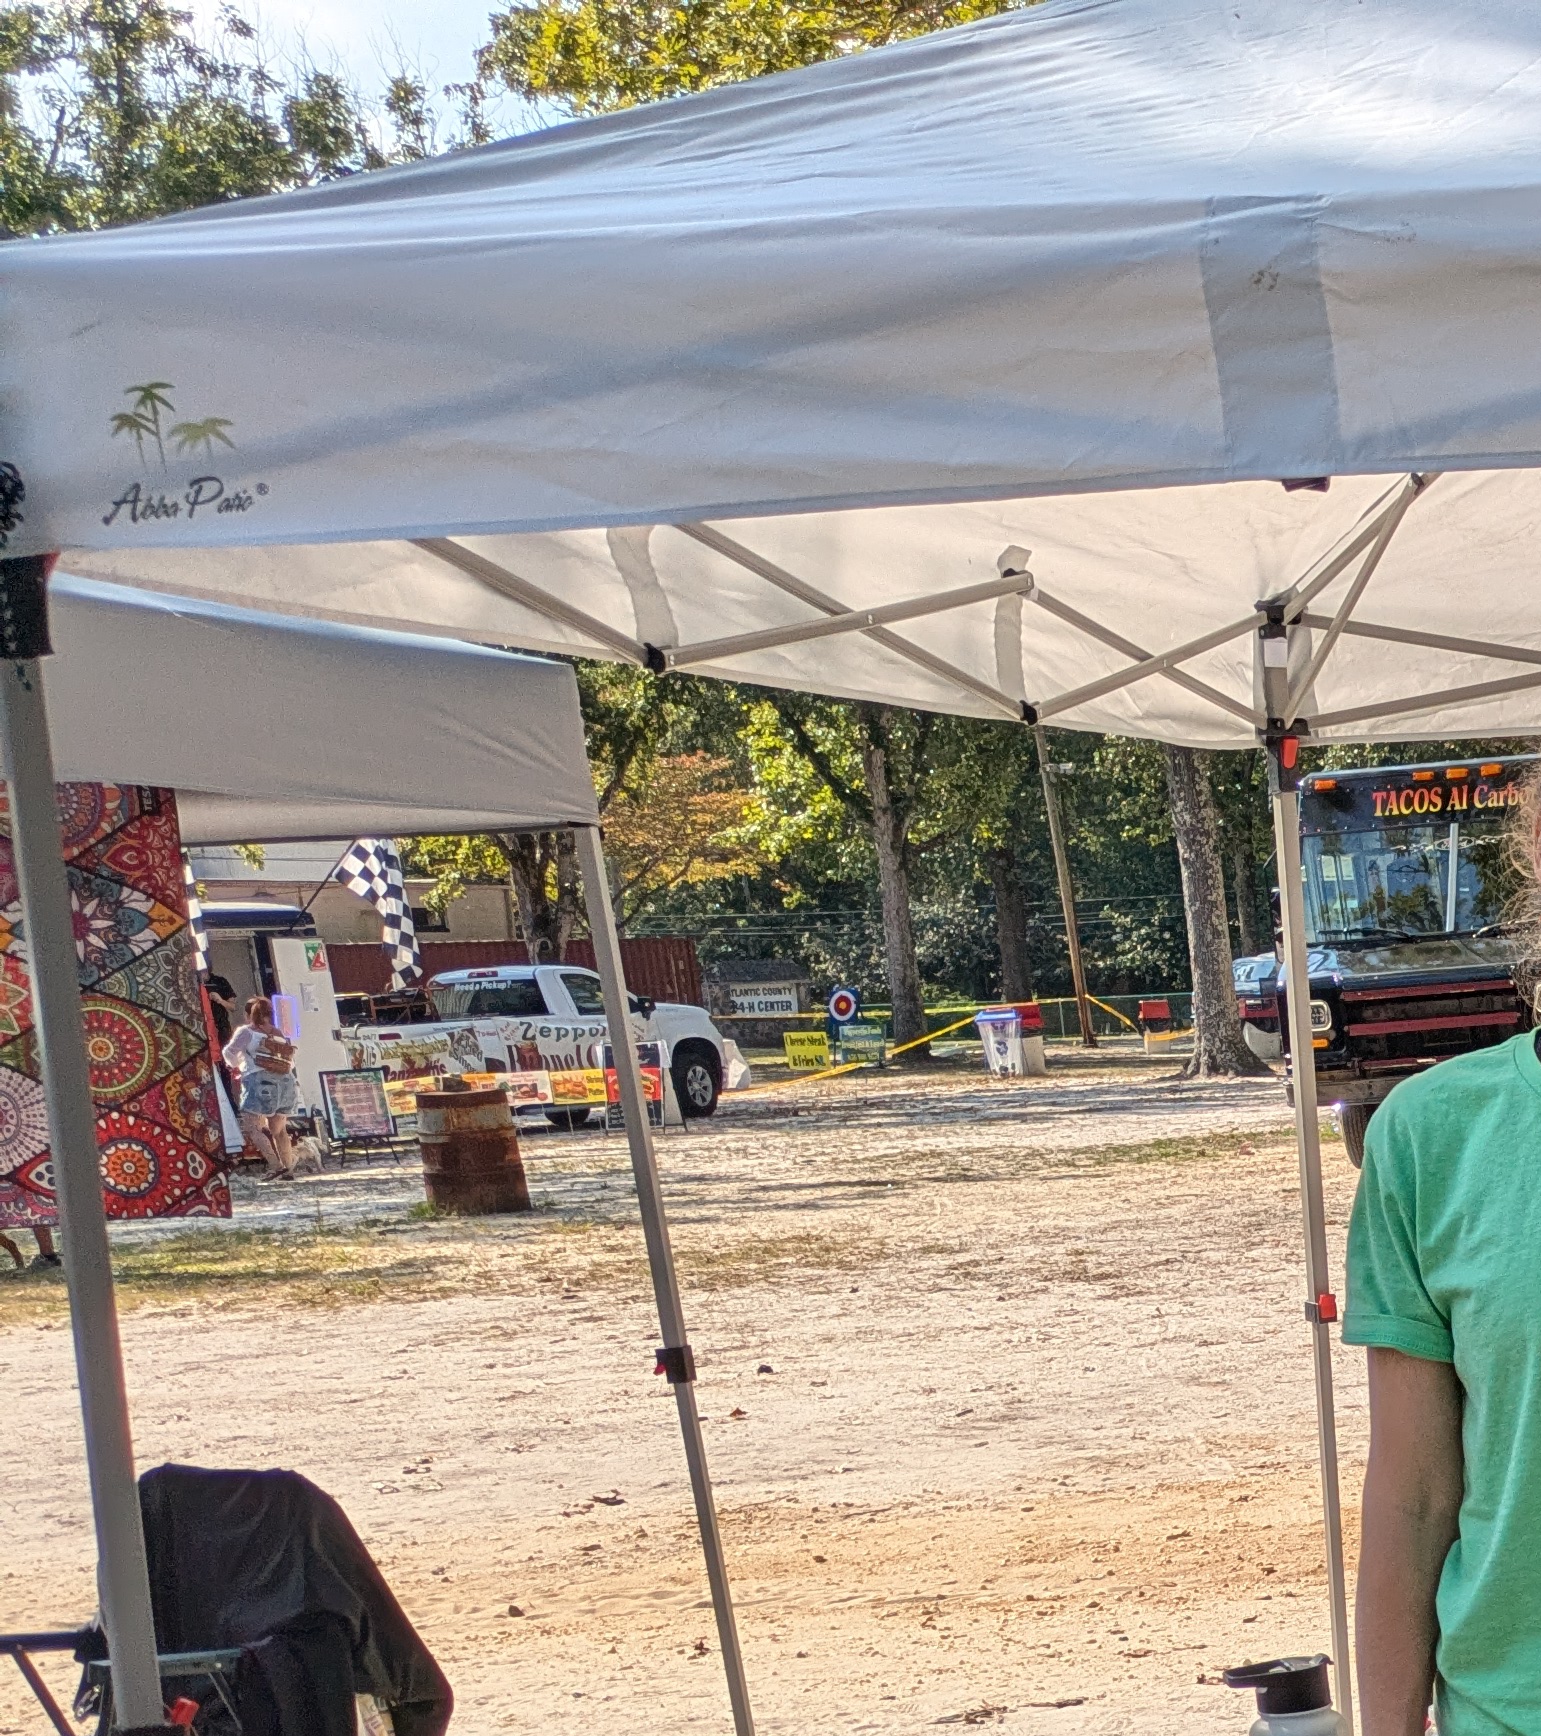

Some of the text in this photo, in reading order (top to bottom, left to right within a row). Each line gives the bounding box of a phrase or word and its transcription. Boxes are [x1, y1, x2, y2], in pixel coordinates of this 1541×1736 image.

[1371, 781, 1530, 817] TACOS Al Carbo
[454, 981, 474, 991] Need
[481, 980, 511, 991] Pickup?
[730, 986, 792, 999] TLANTIC COUNTY
[757, 999, 793, 1013] CENTER
